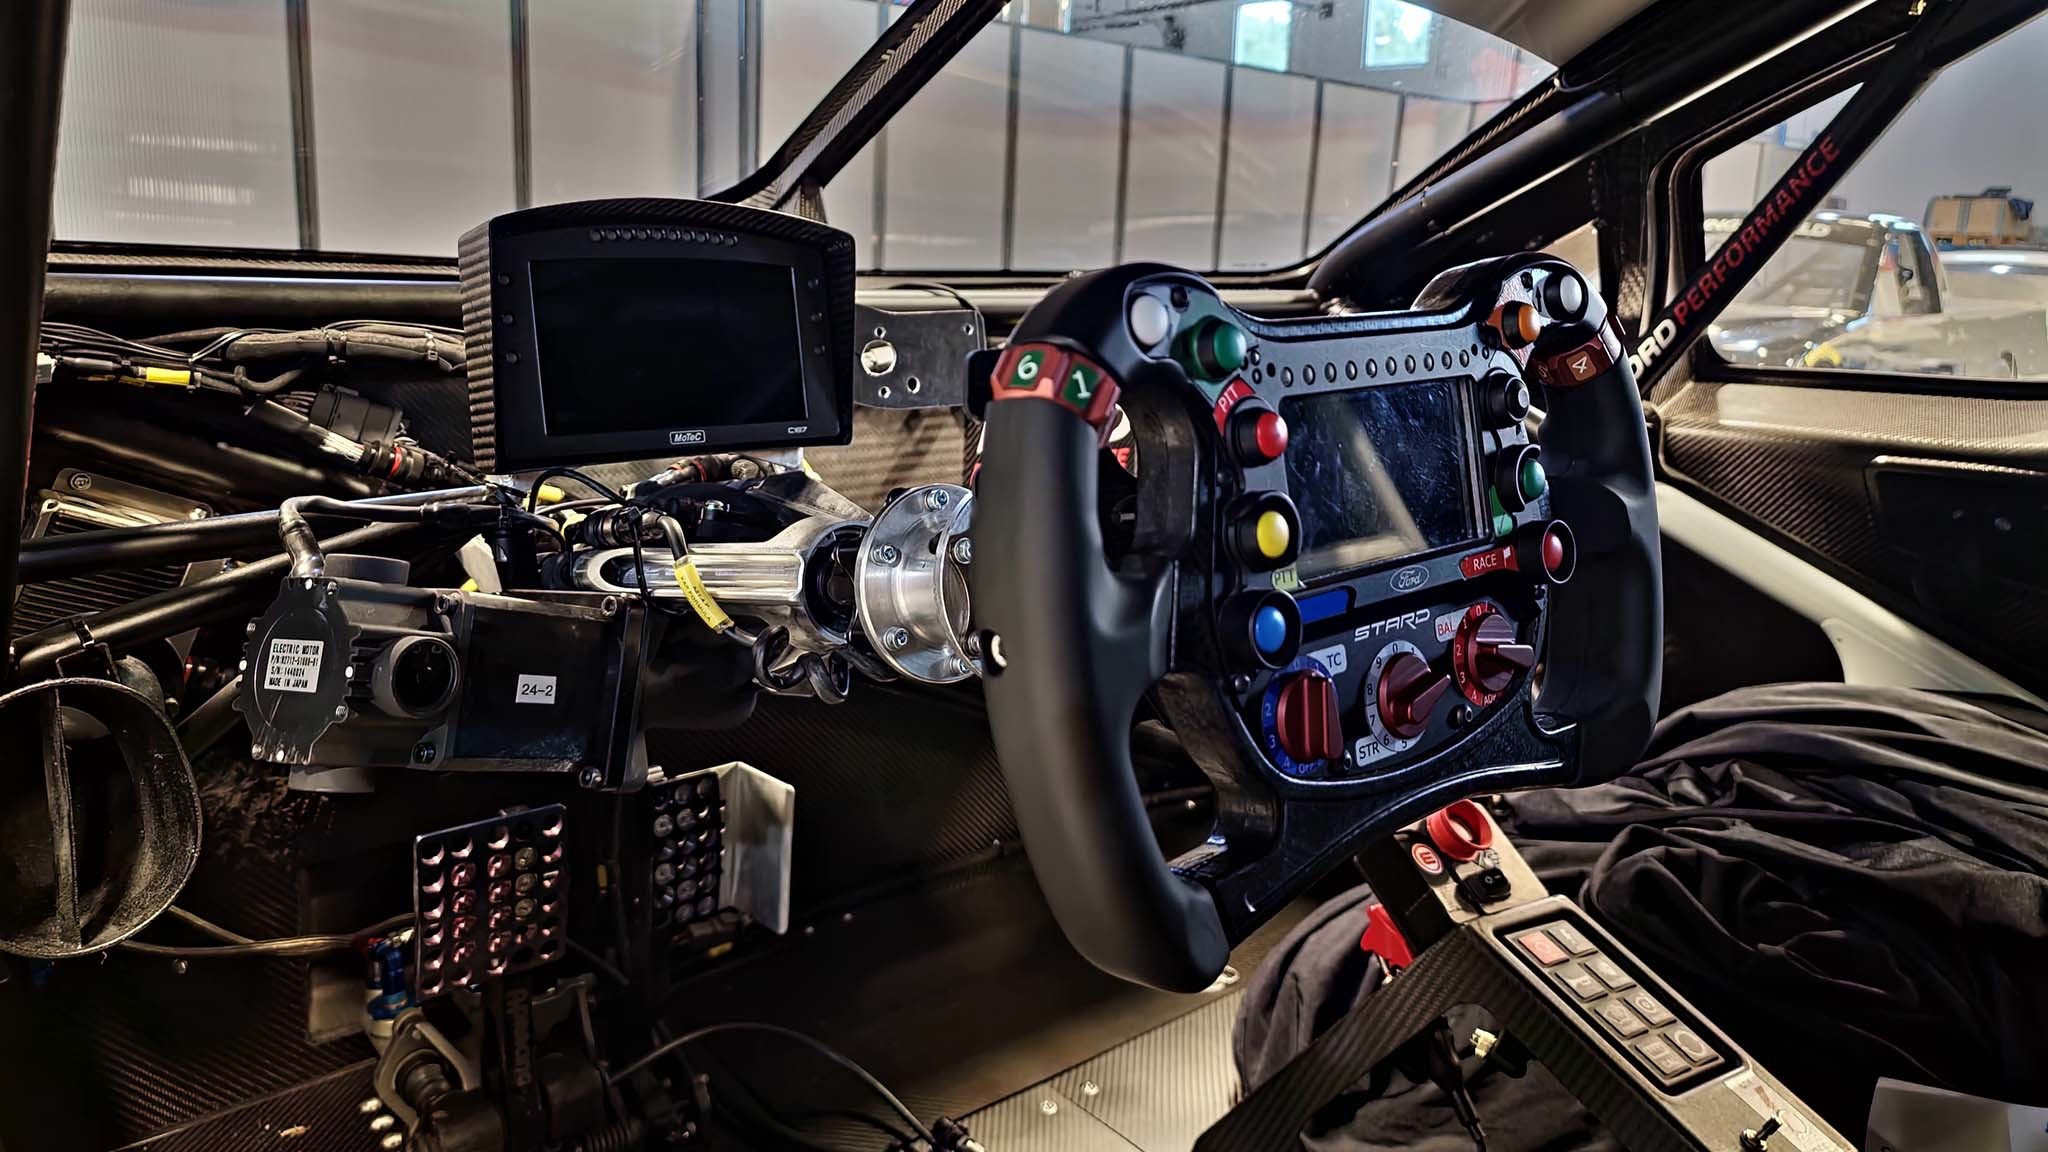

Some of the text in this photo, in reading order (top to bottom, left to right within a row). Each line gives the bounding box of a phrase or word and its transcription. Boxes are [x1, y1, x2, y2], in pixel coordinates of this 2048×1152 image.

[1628, 135, 1841, 381] ORD PERFORMANCE
[1017, 354, 1039, 380] 6
[1571, 355, 1588, 374] 4
[1071, 369, 1092, 399] 1
[673, 432, 703, 442] MoTeC
[1473, 554, 1498, 571] RACE
[1354, 608, 1430, 642] STARD
[1437, 621, 1457, 636] BAL
[272, 643, 320, 655] ELECTRIC MOTOR
[1392, 643, 1399, 654] 0
[1456, 645, 1462, 657] 2
[1326, 652, 1342, 669] TC
[1376, 656, 1382, 669] 9
[269, 677, 309, 688] MADE IN JAPAN
[1460, 672, 1466, 684] 3
[521, 683, 553, 696] 24-2
[1367, 683, 1373, 696] 8
[1264, 703, 1272, 717] 2
[1370, 714, 1376, 727] 7
[1268, 734, 1276, 749] 3
[1383, 734, 1390, 746] 6
[1402, 737, 1408, 749] 5
[1358, 741, 1380, 760] STR
